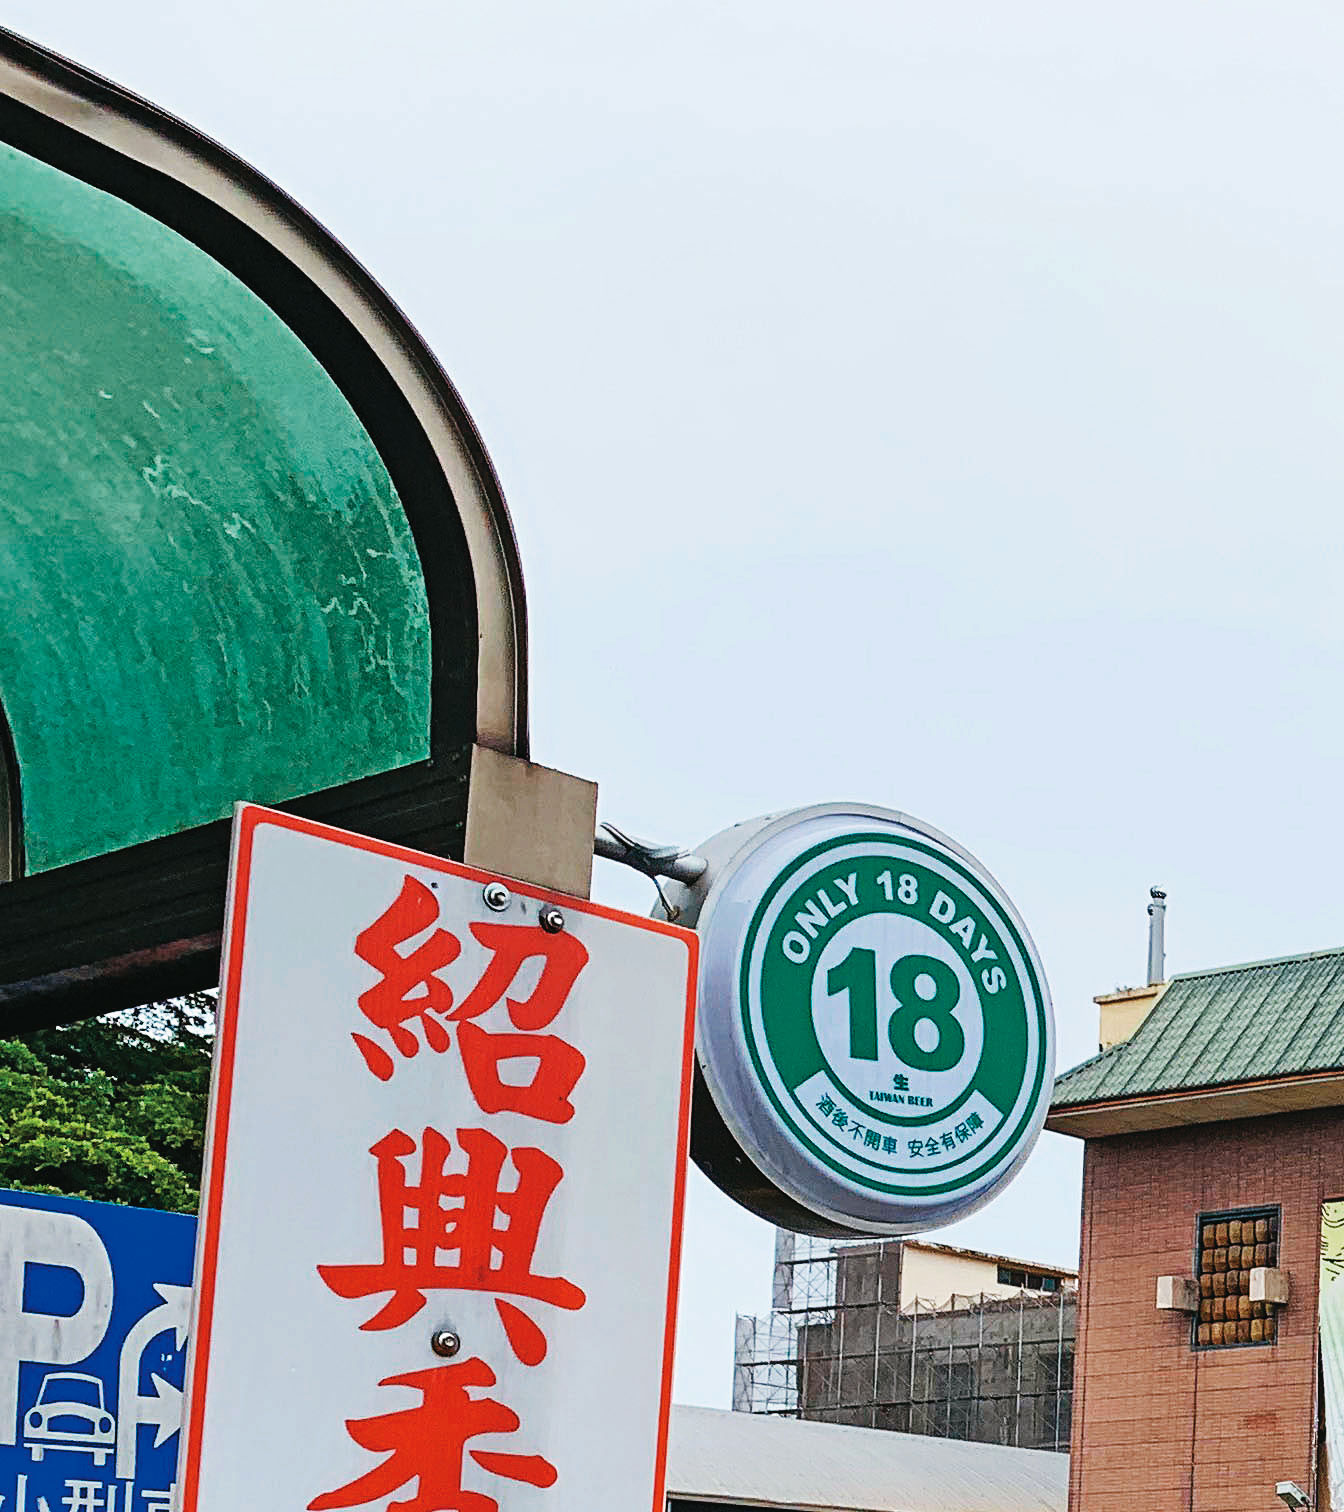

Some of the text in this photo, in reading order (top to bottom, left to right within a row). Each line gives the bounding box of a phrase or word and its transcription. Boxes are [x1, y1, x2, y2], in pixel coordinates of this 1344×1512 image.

[782, 870, 1007, 995] ONLY 18 DAYS
[826, 946, 966, 1072] 18
[869, 1090, 934, 1108] TAIWAN BEER
[892, 1073, 910, 1092] 生
[815, 1091, 985, 1158] 酒後不開車 安全有保障
